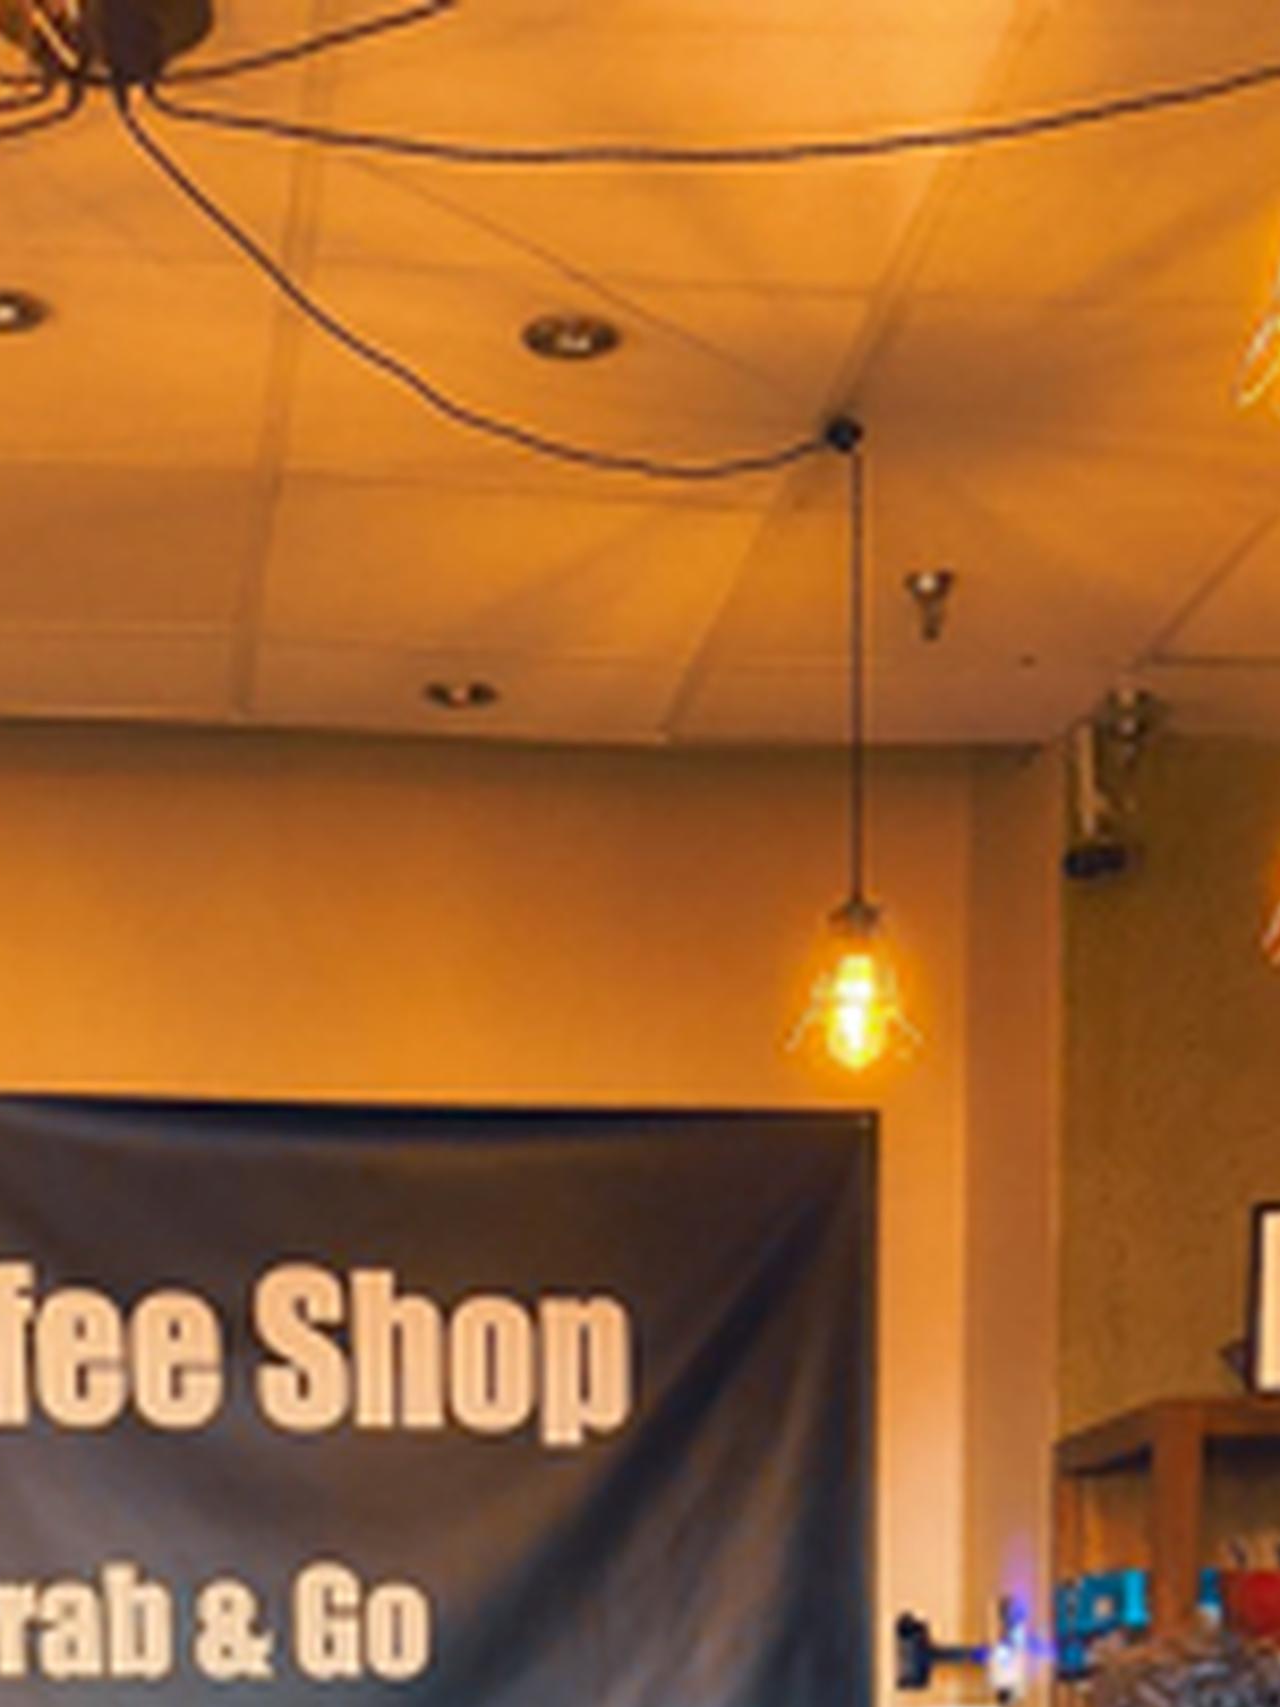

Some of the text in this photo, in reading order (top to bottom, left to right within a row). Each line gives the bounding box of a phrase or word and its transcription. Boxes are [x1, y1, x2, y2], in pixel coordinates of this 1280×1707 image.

[254, 1264, 631, 1448] Shop
[194, 1580, 274, 1681] &
[293, 1562, 430, 1681] Go
